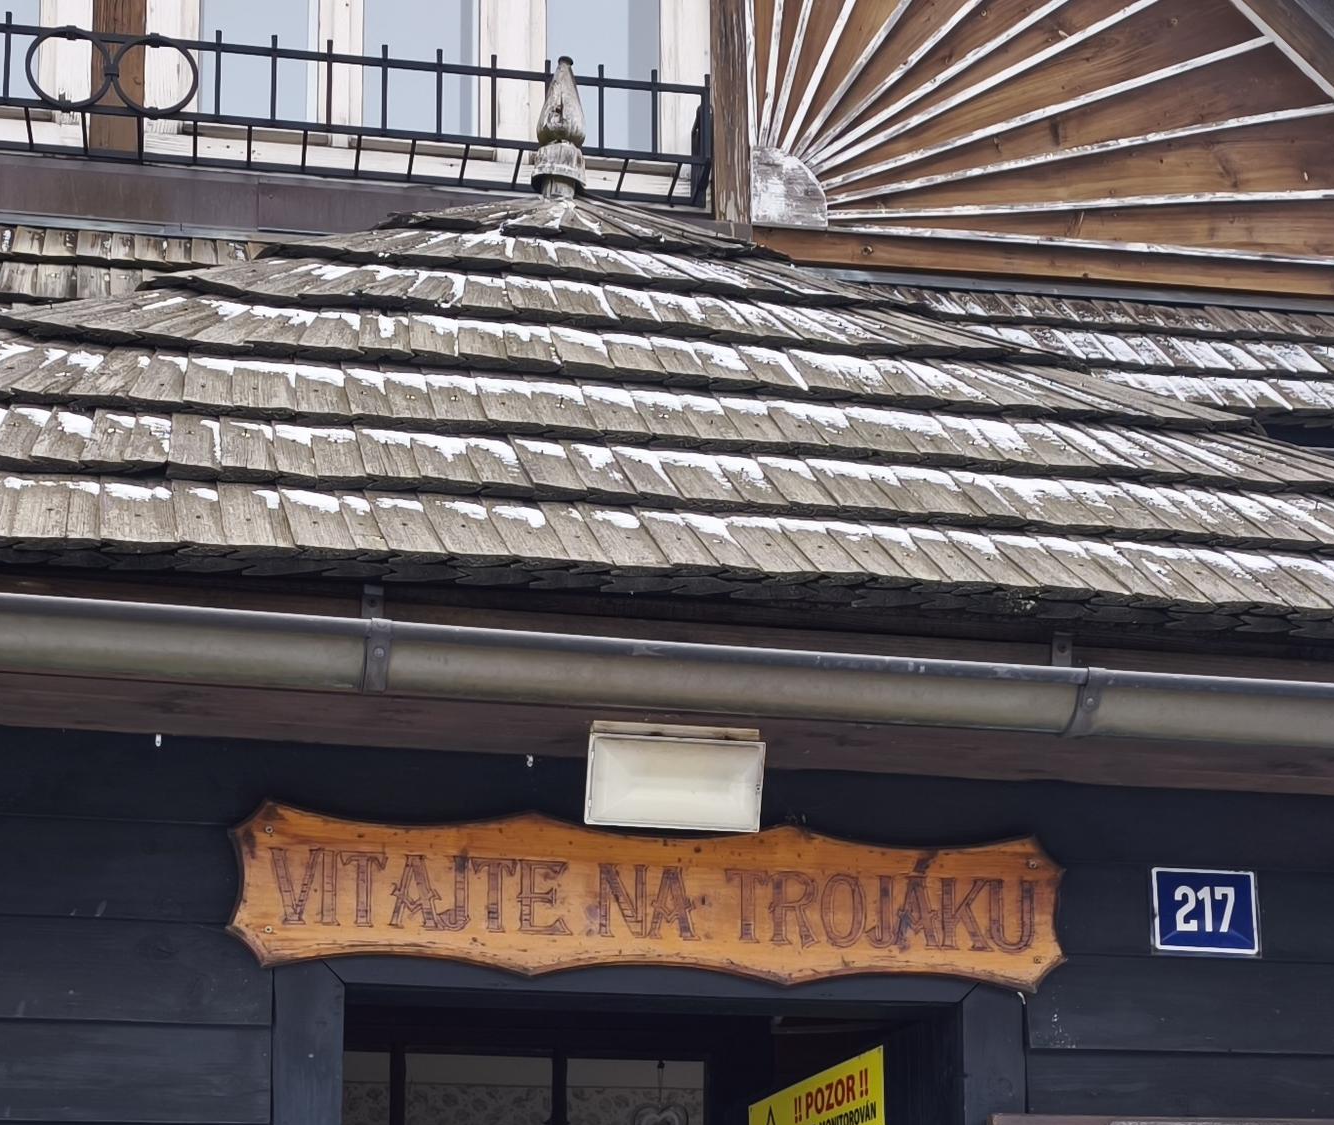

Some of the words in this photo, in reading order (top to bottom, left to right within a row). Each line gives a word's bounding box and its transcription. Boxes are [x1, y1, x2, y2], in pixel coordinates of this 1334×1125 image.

[268, 846, 573, 938] VITAJTE
[597, 860, 701, 942] NA
[724, 849, 1039, 954] TROJÁKU
[1173, 885, 1236, 933] 217
[805, 1073, 857, 1120] POZOR
